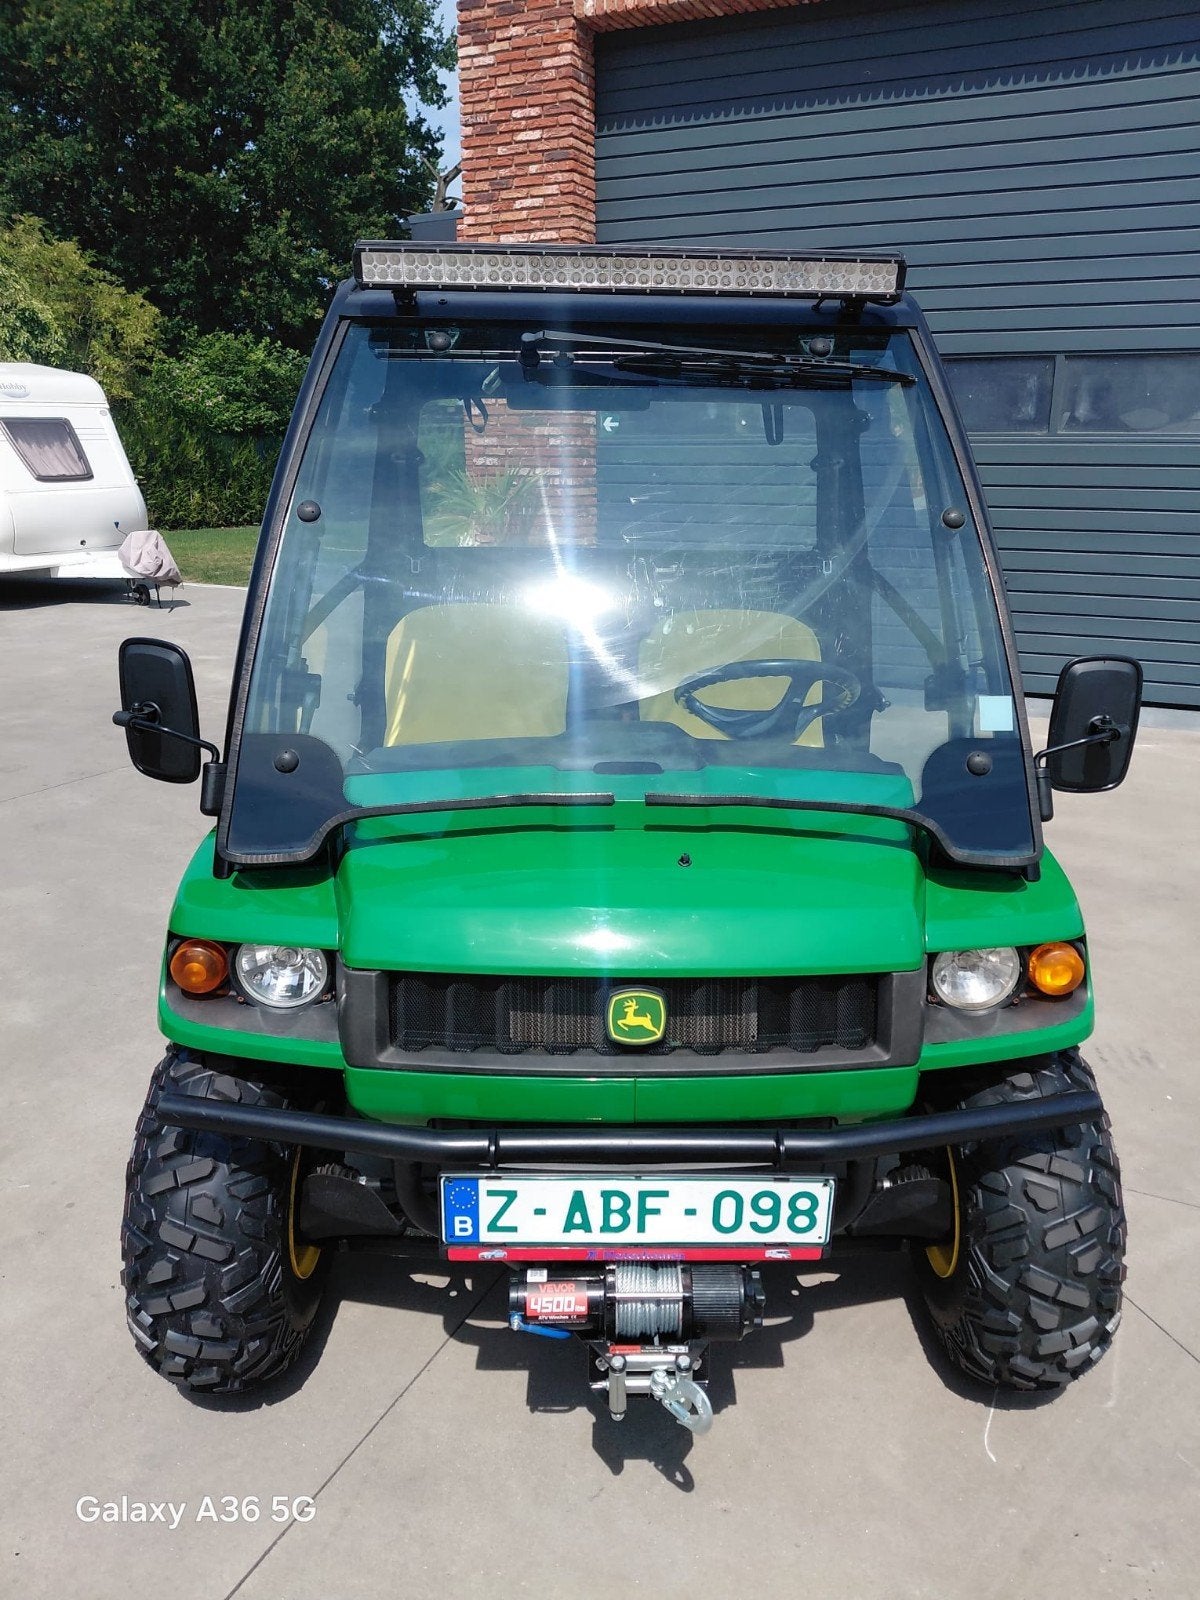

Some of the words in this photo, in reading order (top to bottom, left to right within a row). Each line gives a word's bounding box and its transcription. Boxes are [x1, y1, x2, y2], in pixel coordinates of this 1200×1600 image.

[454, 1216, 474, 1237] B
[538, 1283, 576, 1293] VEVOR
[530, 1296, 576, 1314] 4500
